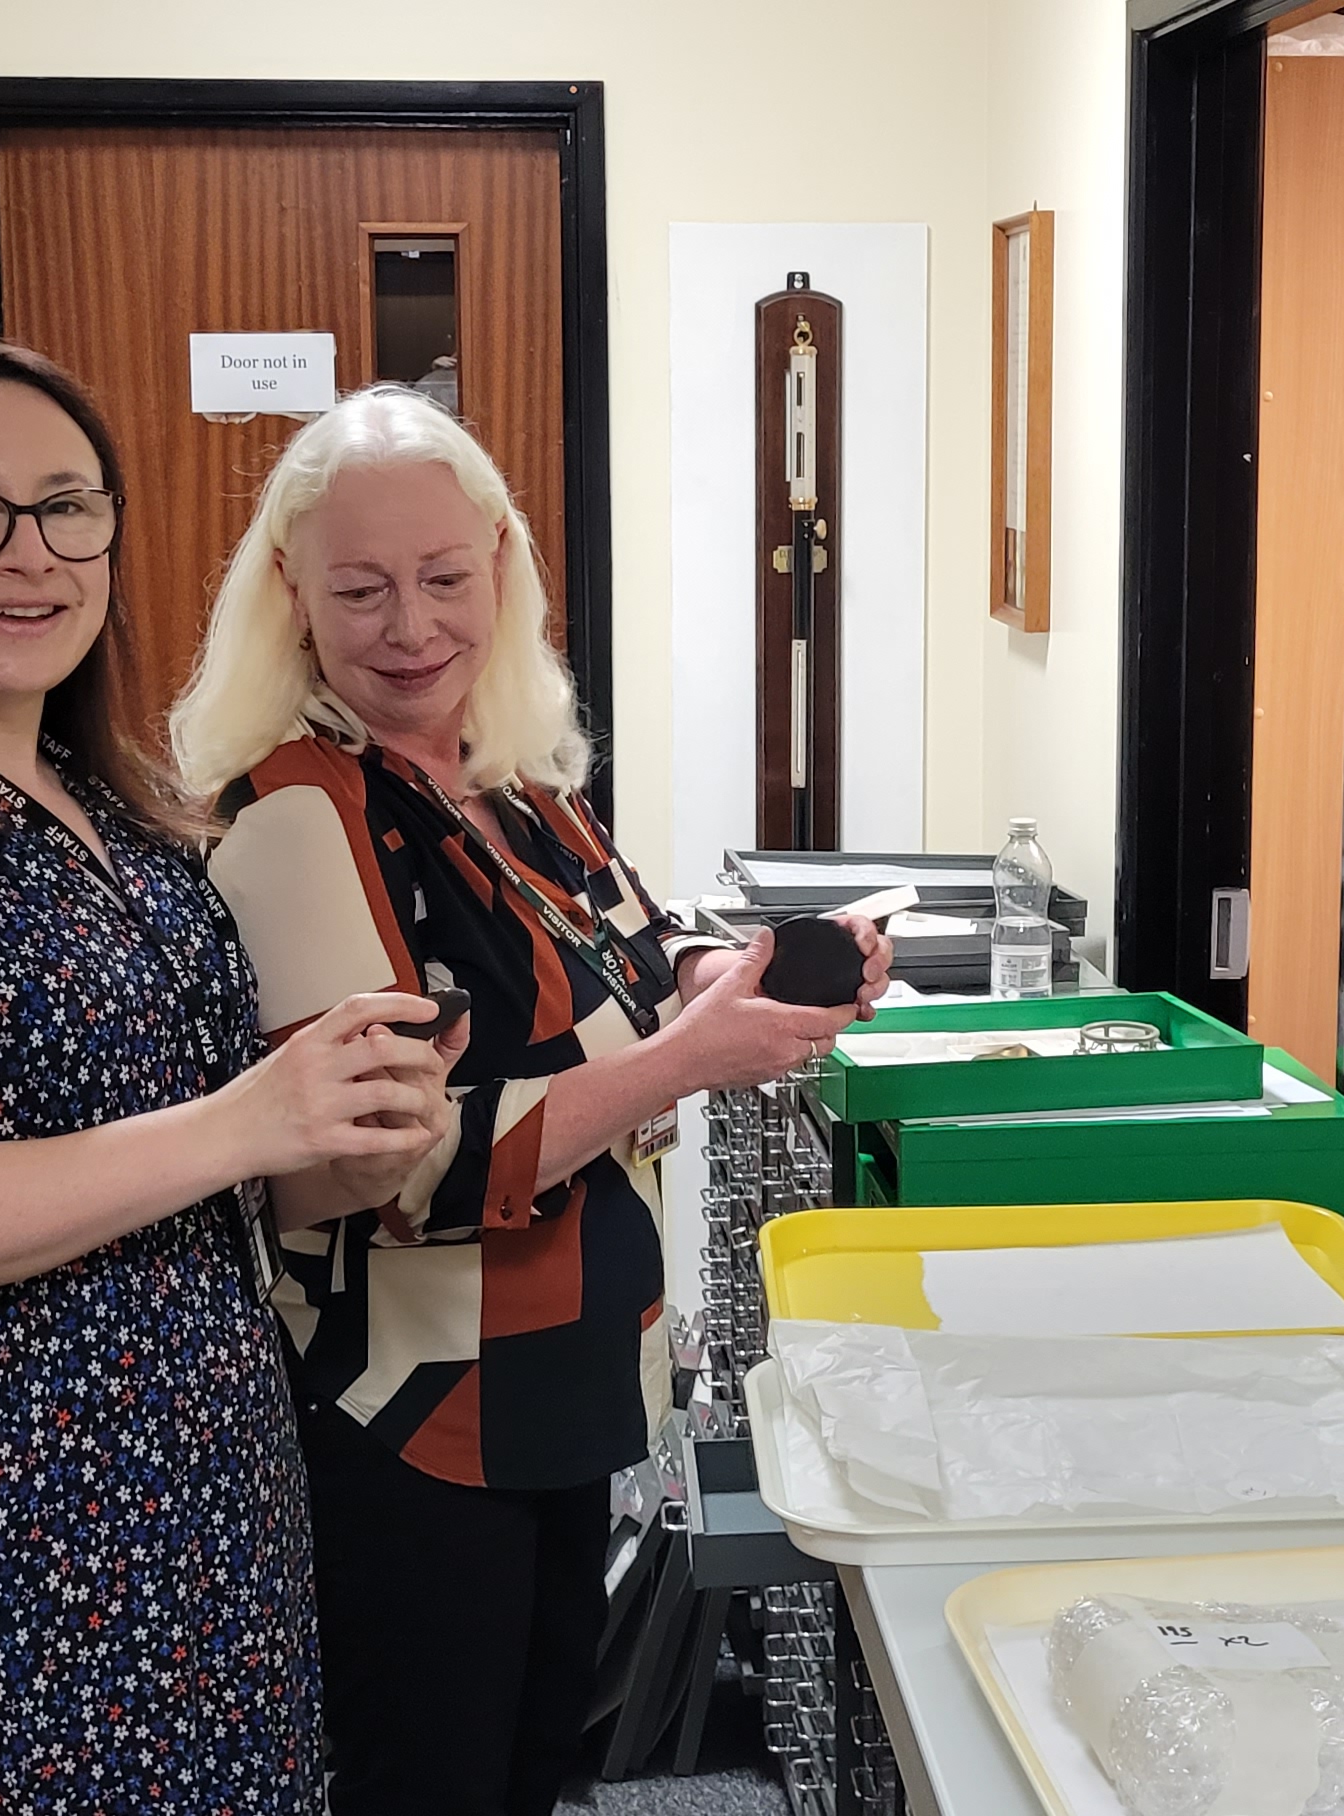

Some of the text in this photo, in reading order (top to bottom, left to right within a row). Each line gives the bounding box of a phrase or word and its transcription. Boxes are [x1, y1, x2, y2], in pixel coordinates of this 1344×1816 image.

[221, 354, 307, 369] Door not in
[252, 379, 278, 390] use
[39, 731, 72, 760] TAFF
[88, 775, 128, 809] STAFF
[427, 777, 463, 821] VISITOR
[44, 825, 89, 862] STAFF
[486, 841, 521, 885] VISITOR
[199, 879, 227, 920] STAFF
[543, 905, 582, 948] VISITOR
[224, 941, 240, 989] STAFF
[602, 967, 637, 1012] VISITOR
[195, 1017, 219, 1065] STAFF
